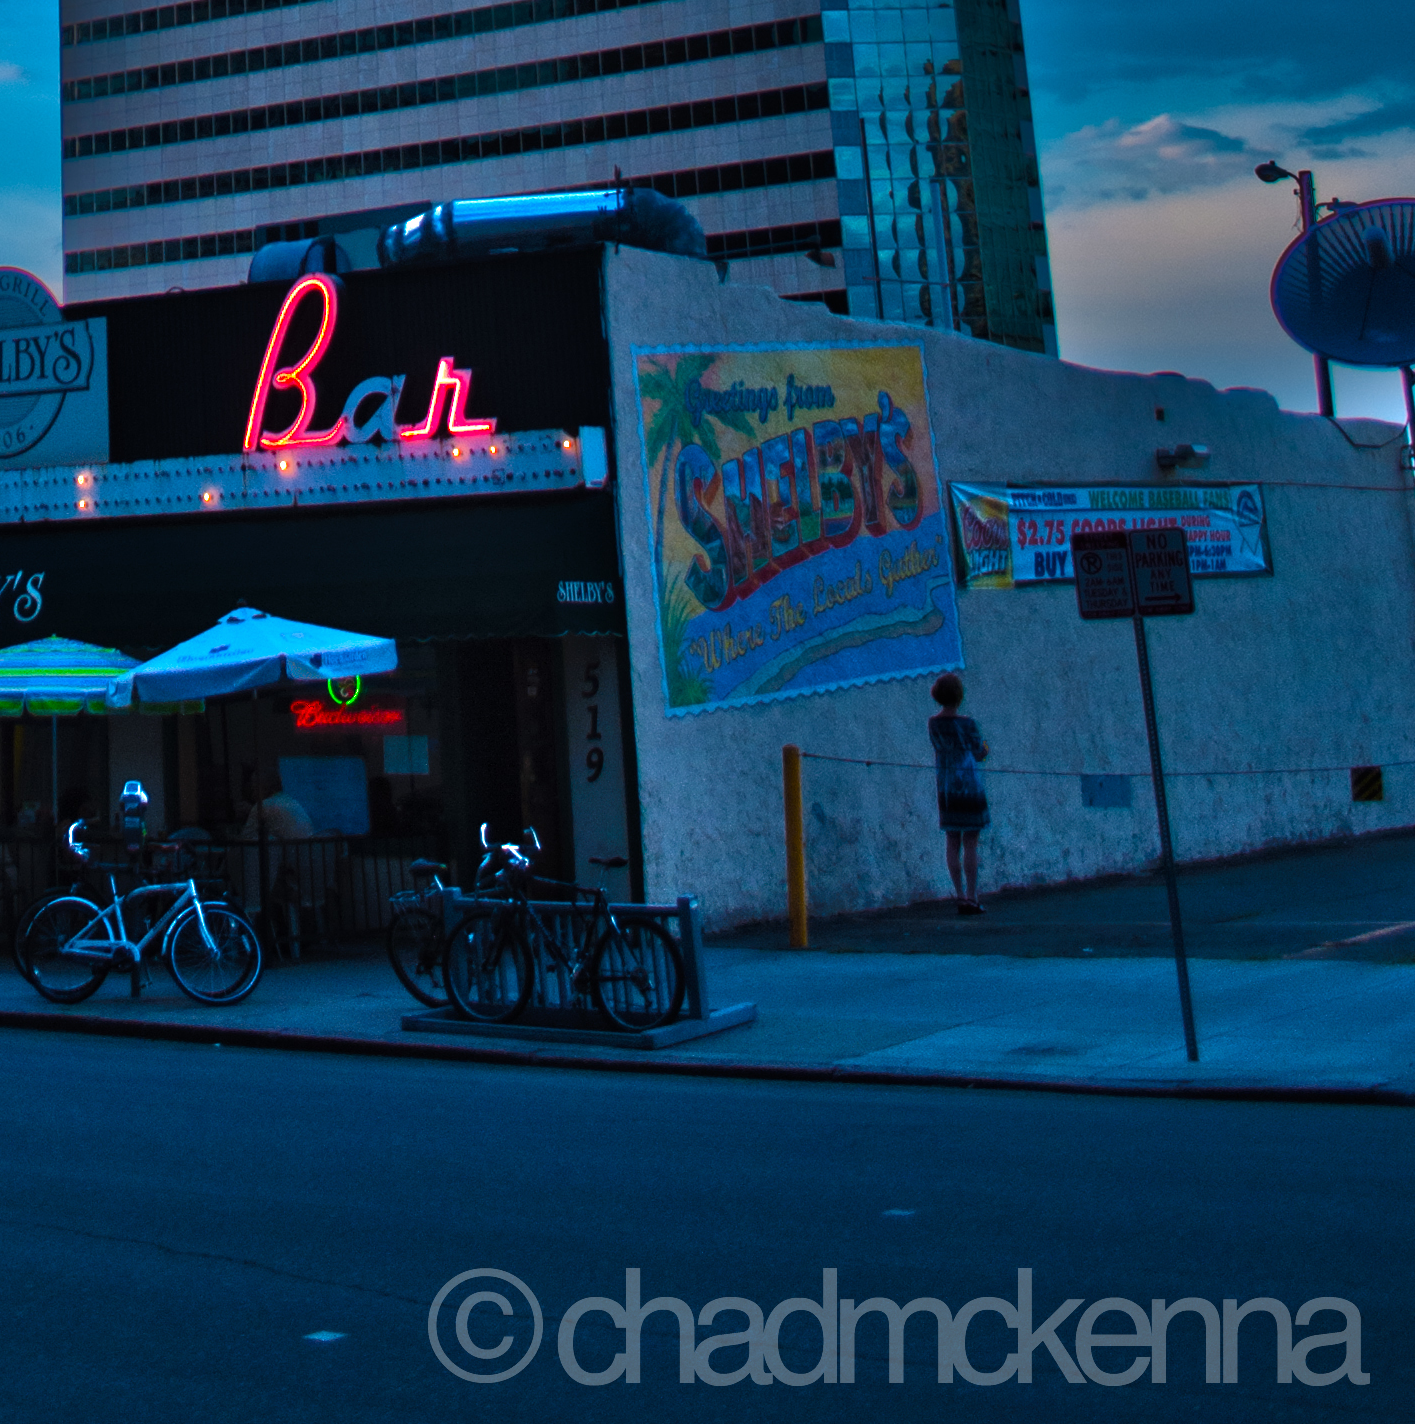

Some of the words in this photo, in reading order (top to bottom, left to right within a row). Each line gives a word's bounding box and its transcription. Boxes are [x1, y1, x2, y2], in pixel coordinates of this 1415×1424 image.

[0, 275, 49, 318] GRILL
[243, 271, 498, 452] Bar
[686, 382, 778, 427] Greetings
[784, 374, 835, 421] from
[675, 391, 924, 612] SHELBY'S
[1088, 490, 1144, 510] WELCOME
[1149, 490, 1198, 509] BASEBALL
[1203, 490, 1230, 509] FANS
[1016, 519, 1066, 549] $2.75
[1146, 533, 1168, 550] NO
[1187, 530, 1207, 542] APPY
[1034, 551, 1068, 577] BUY
[1135, 550, 1184, 569] PARKING
[1150, 568, 1172, 580] ANY
[1150, 580, 1175, 592] TIME
[556, 581, 615, 604] SHELBY'S
[769, 594, 806, 642] The
[813, 561, 873, 617] Locals
[1085, 598, 1128, 610] THURSDAY
[582, 661, 605, 782] 519
